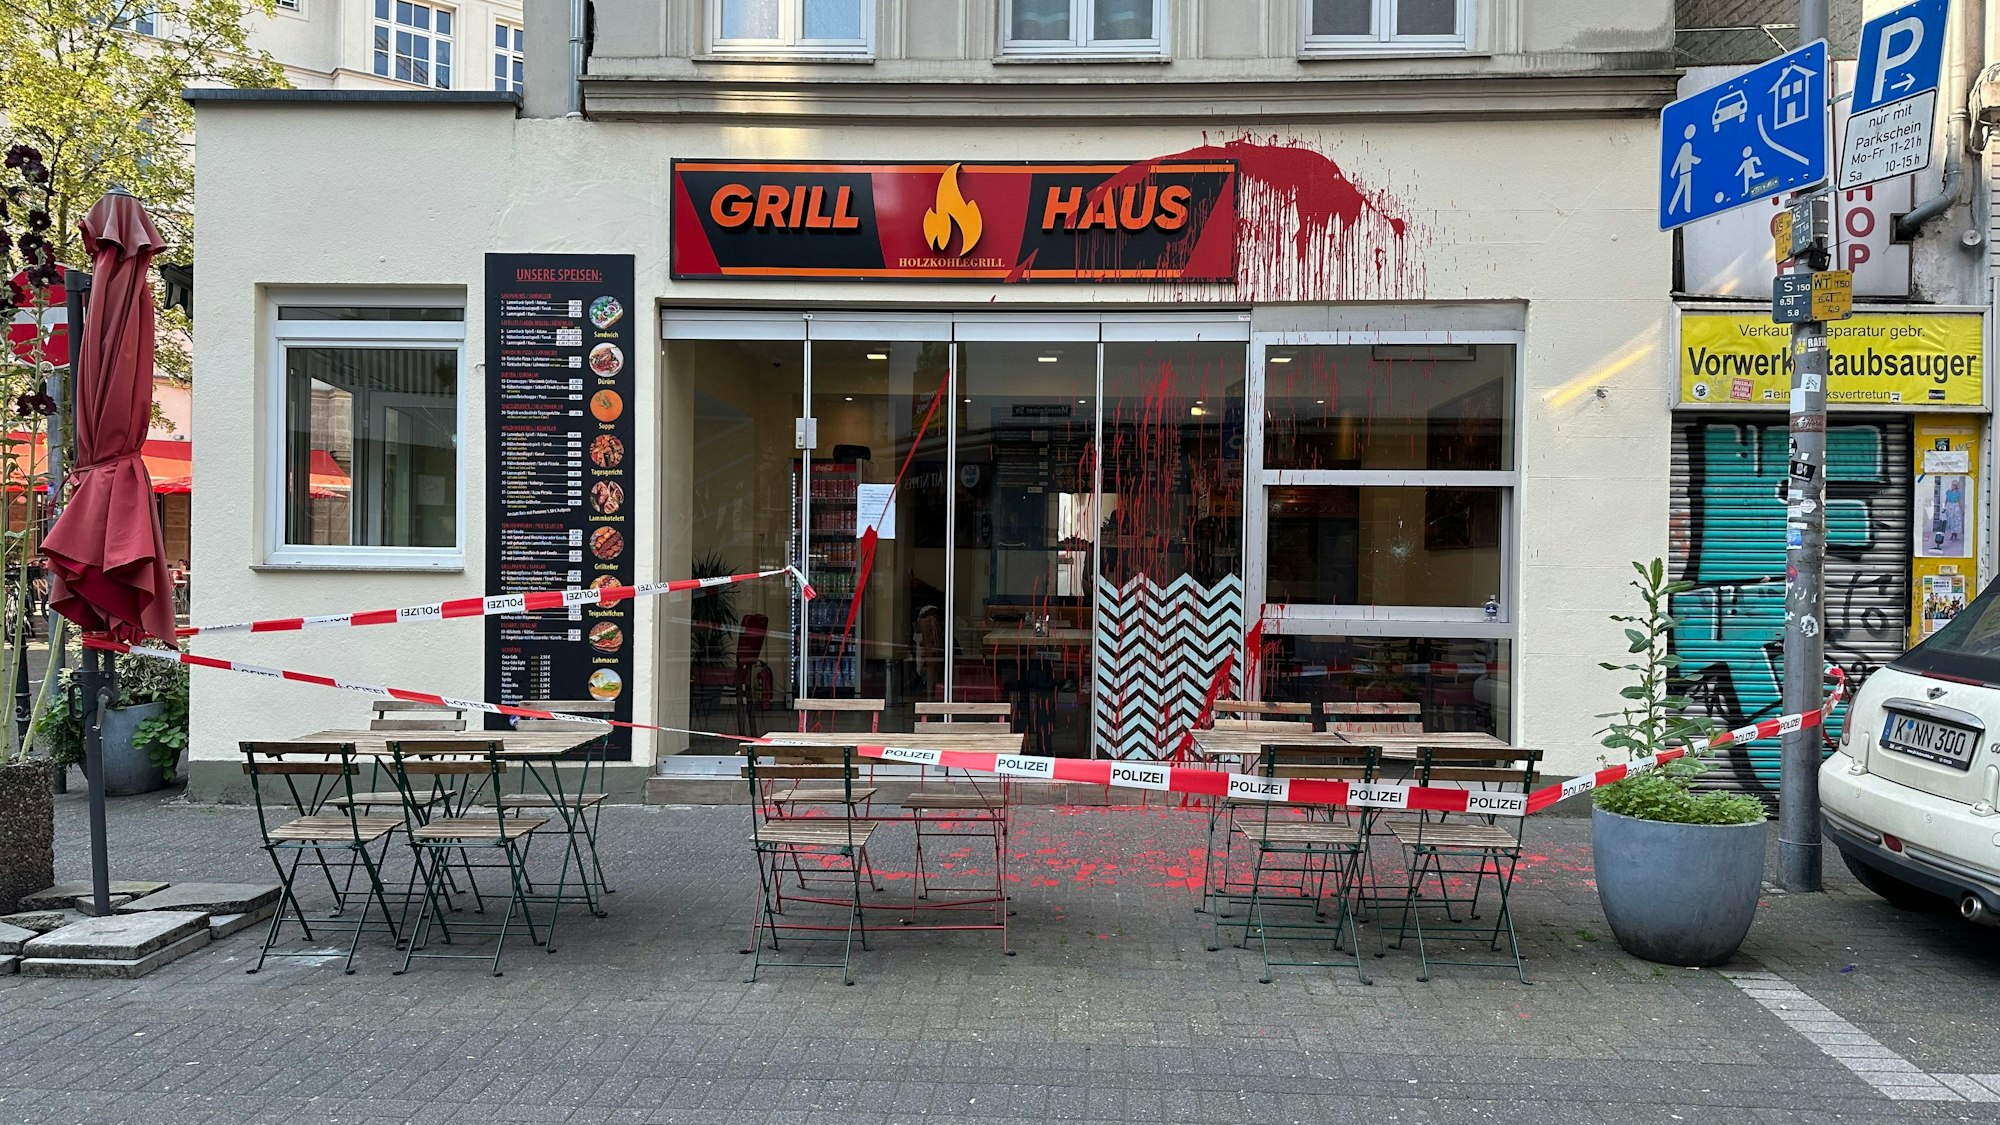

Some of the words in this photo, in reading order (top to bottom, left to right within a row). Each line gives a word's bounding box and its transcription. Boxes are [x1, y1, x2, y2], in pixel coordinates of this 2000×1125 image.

[1871, 17, 1924, 104] P
[1868, 113, 1890, 128] nur
[1893, 103, 1913, 121] mit
[1856, 122, 1922, 150] Parkschein
[1851, 147, 1884, 166] Mo-Fr
[1890, 137, 1914, 154] 11-21
[1849, 171, 1862, 182] Sa
[1885, 155, 1912, 172] 10-15
[1914, 154, 1920, 165] h
[709, 183, 859, 229] GRILL
[1042, 185, 1192, 230] HAUS
[898, 256, 1006, 268] HOLZKOHLEGRILL
[516, 269, 555, 280] UNSERE
[558, 269, 602, 280] SPEISEN:
[1784, 282, 1793, 292] S
[1814, 278, 1830, 289] WT
[1826, 324, 1886, 339] eparatur
[1890, 324, 1926, 340] gebr.
[1688, 347, 1793, 376] Vorwerk
[1828, 347, 1976, 384] taubsauger
[1827, 390, 1890, 400] ksvertretun
[566, 589, 600, 600] POLIZEI
[401, 606, 440, 616] POLIZEI
[486, 598, 523, 610] POLIZEI
[1780, 718, 1800, 730] POLIZEI
[1894, 718, 1908, 740] K
[1912, 722, 1935, 748] NN
[1935, 728, 1966, 756] 300
[884, 749, 935, 760] POLIZEI
[997, 758, 1048, 773] POLIZEI
[1112, 768, 1164, 784] POLIZEI
[1230, 780, 1283, 795] POLIZEI
[1350, 789, 1402, 803] POLIZEI
[1470, 796, 1522, 810] POLIZEI
